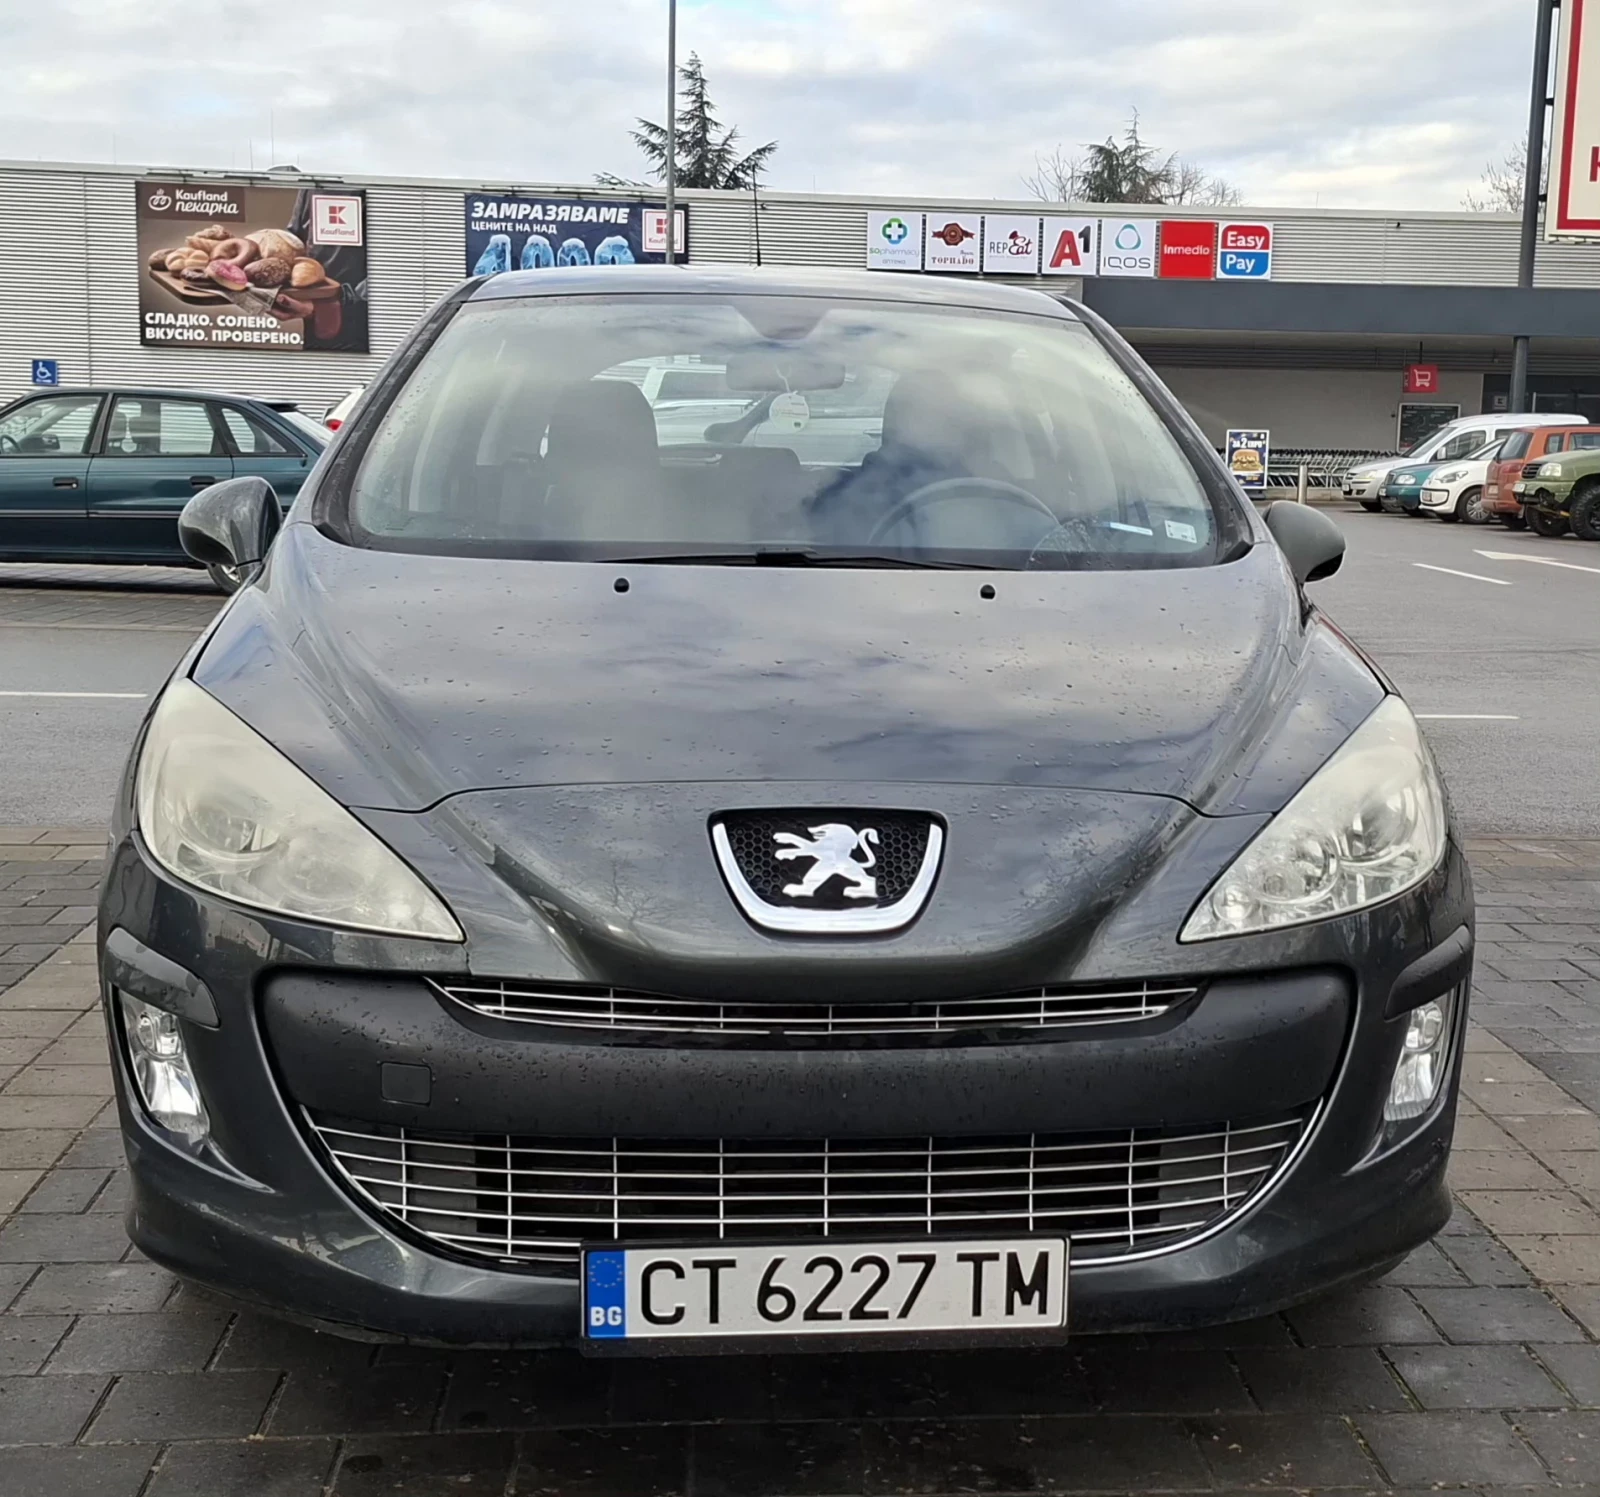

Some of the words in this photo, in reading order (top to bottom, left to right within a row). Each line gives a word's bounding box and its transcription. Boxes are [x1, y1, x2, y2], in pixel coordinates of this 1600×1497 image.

[175, 189, 228, 202] Kaufland
[175, 201, 239, 216] пекарна
[471, 202, 630, 224] ЗАМРАЗЯВАМЕ
[320, 228, 356, 237] Kaufland
[471, 221, 514, 232] ЦЕНИТЕ
[515, 223, 530, 232] НА
[533, 224, 558, 234] НАД
[1049, 225, 1091, 268] A1
[1227, 231, 1265, 250] Easy
[1163, 245, 1210, 256] Inmedio
[1103, 256, 1151, 269] IQOS
[1226, 255, 1256, 273] Pay
[145, 312, 213, 327] СЛАДКО.
[216, 315, 281, 329] СОЛЕНО.
[145, 327, 208, 341] ВКУСНО.
[211, 330, 304, 345] ПРОВЕРЕНО.
[1240, 437, 1248, 448] 2
[640, 1258, 737, 1326] CT
[756, 1253, 937, 1323] 6227
[956, 1250, 1050, 1318] TM
[590, 1307, 622, 1327] BG
